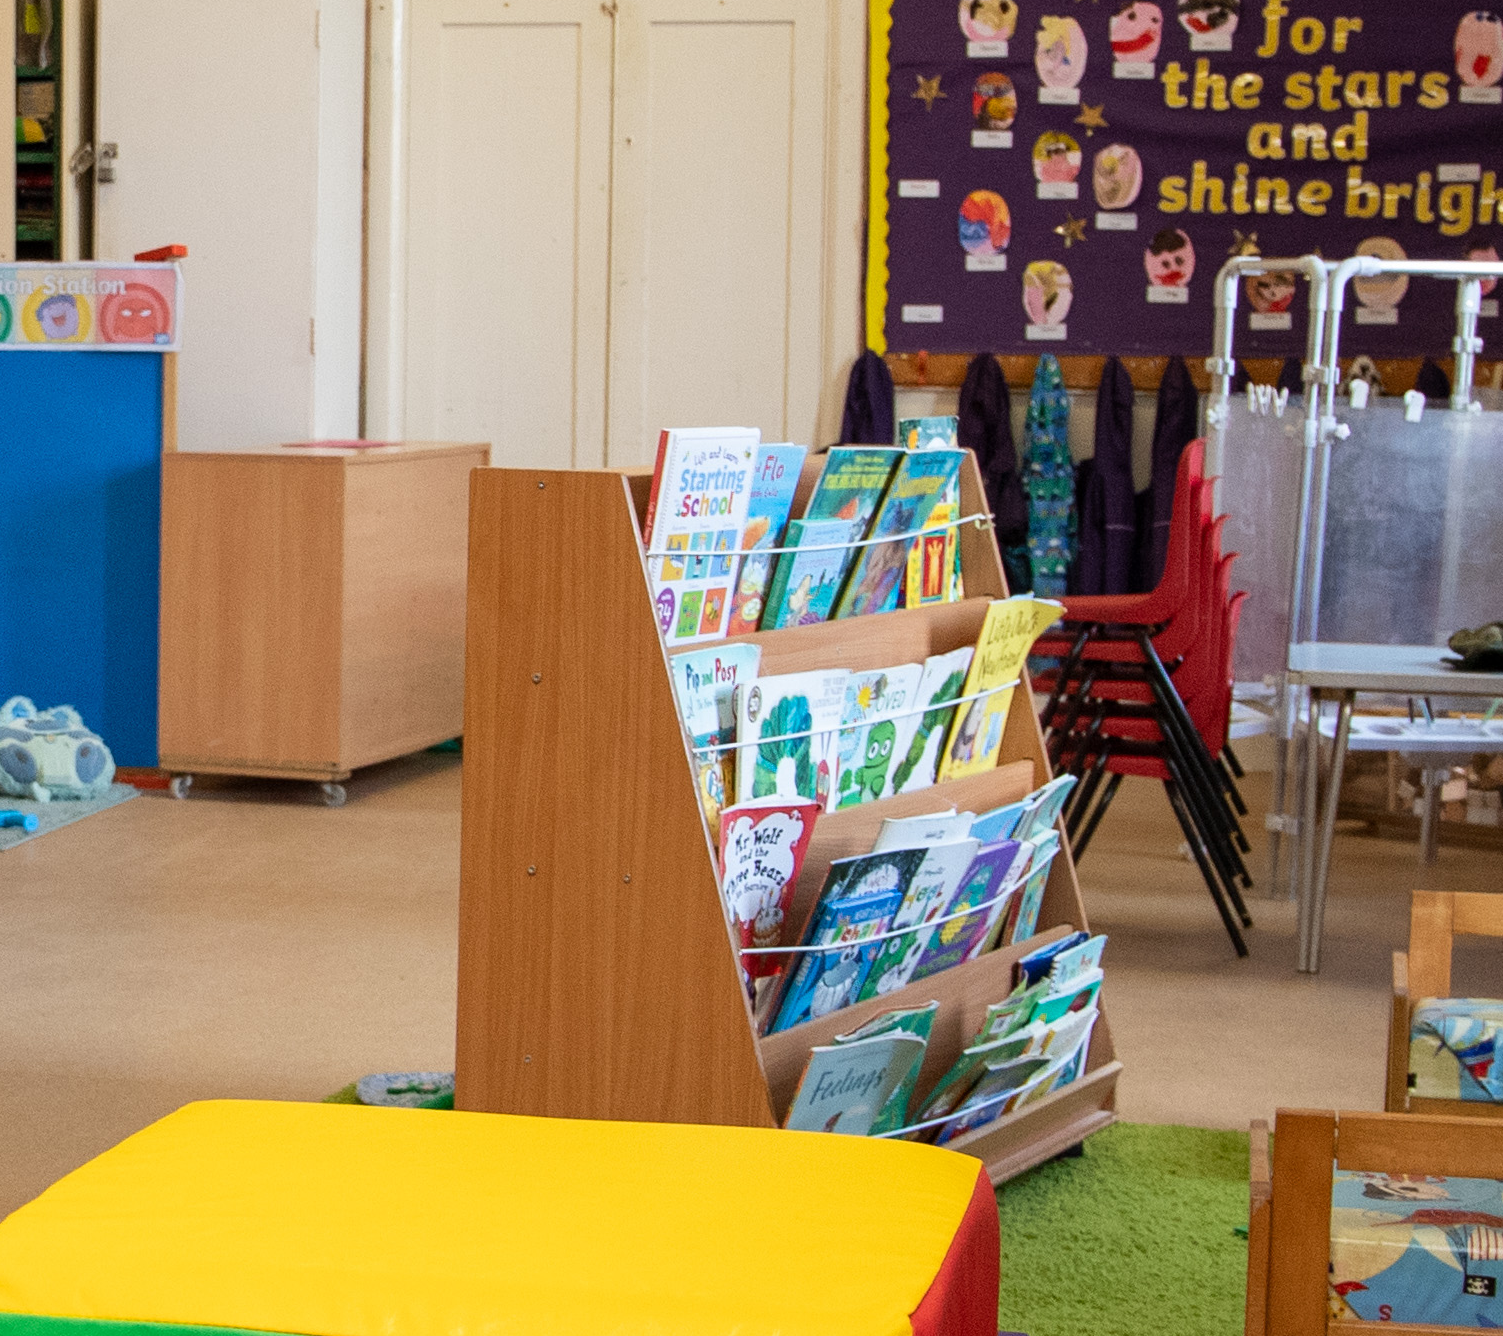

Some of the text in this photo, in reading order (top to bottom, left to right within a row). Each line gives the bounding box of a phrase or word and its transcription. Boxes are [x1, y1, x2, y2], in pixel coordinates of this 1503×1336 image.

[1160, 57, 1450, 111] the stars
[1247, 110, 1370, 161] and
[1157, 160, 1333, 216] shine
[43, 274, 127, 296] Station
[680, 465, 746, 494] Starting
[762, 455, 784, 481] Flo
[681, 491, 734, 517] School
[686, 658, 738, 693] Pip and Posy
[736, 827, 783, 855] Mr Wolf
[740, 847, 769, 863] and the
[726, 859, 785, 901] Three Bears
[809, 1067, 886, 1106] Feelings
